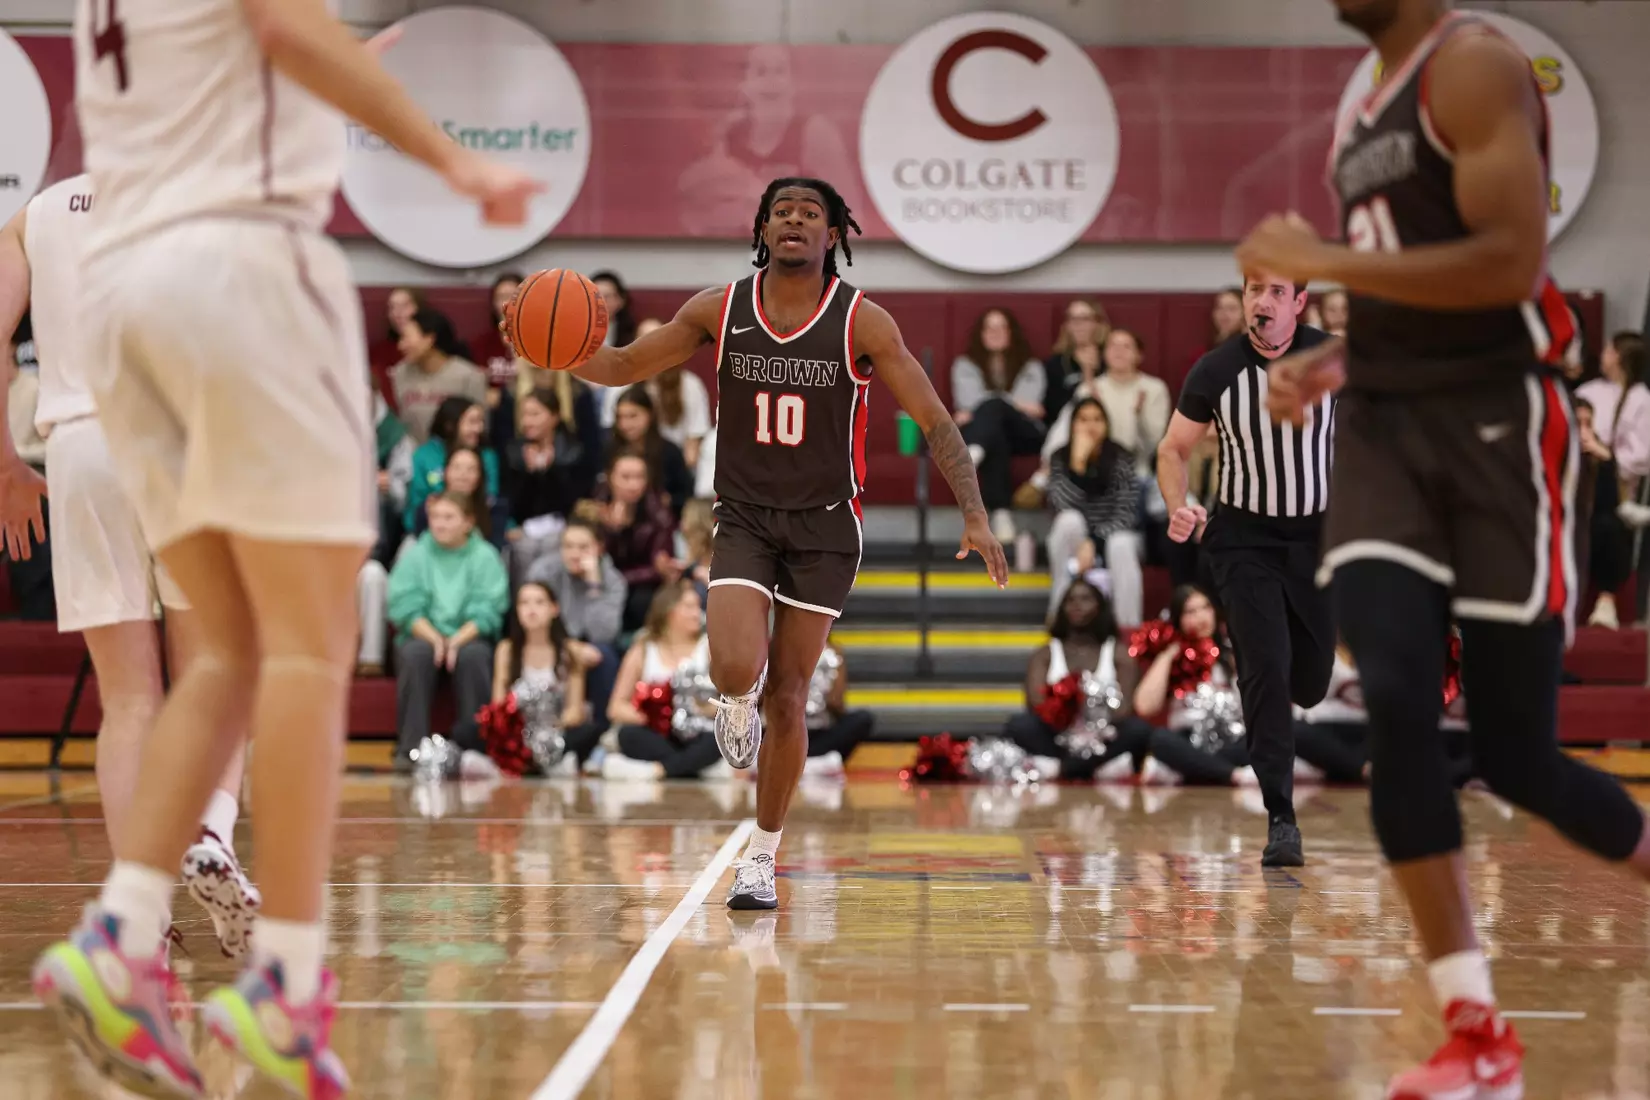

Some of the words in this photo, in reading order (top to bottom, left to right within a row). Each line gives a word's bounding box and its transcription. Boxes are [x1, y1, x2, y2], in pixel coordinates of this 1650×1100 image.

[931, 28, 1050, 142] C
[893, 157, 1088, 192] COLGATE
[902, 197, 1076, 224] BOOKSTORE
[729, 352, 839, 387] BROWN
[754, 391, 807, 447] 10
